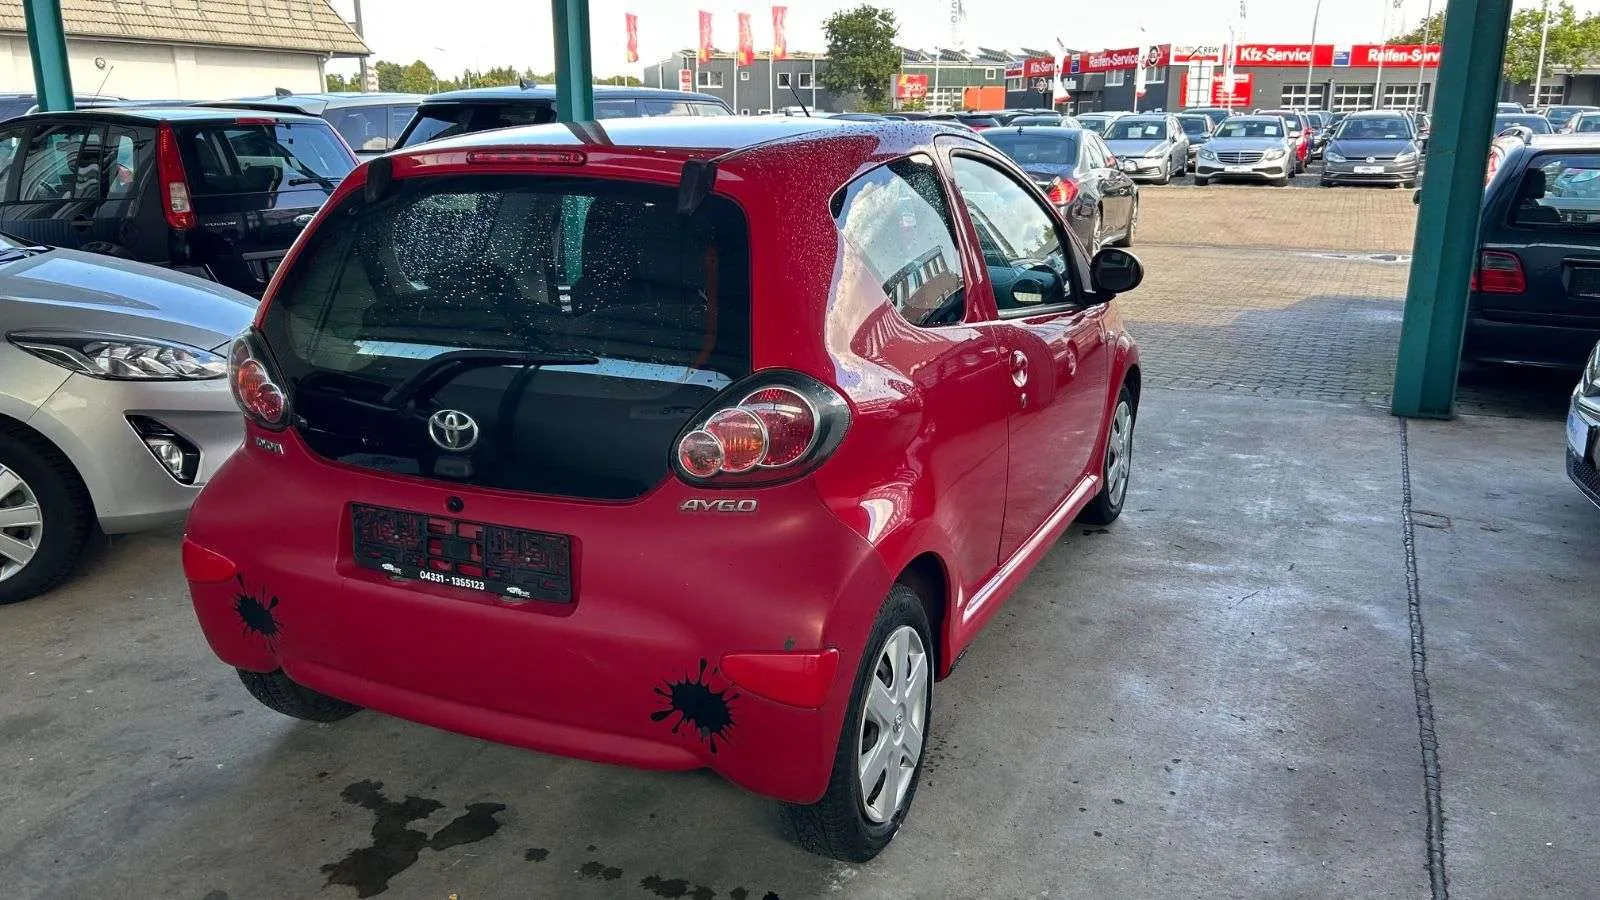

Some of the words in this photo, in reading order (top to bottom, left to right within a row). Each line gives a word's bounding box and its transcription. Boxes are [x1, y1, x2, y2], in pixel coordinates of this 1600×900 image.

[1240, 47, 1312, 62] Kfz-Service
[1368, 48, 1440, 63] Reifen-Srv
[680, 499, 758, 511] AYGO
[419, 570, 444, 583] 04331
[452, 577, 485, 590] 1355123
